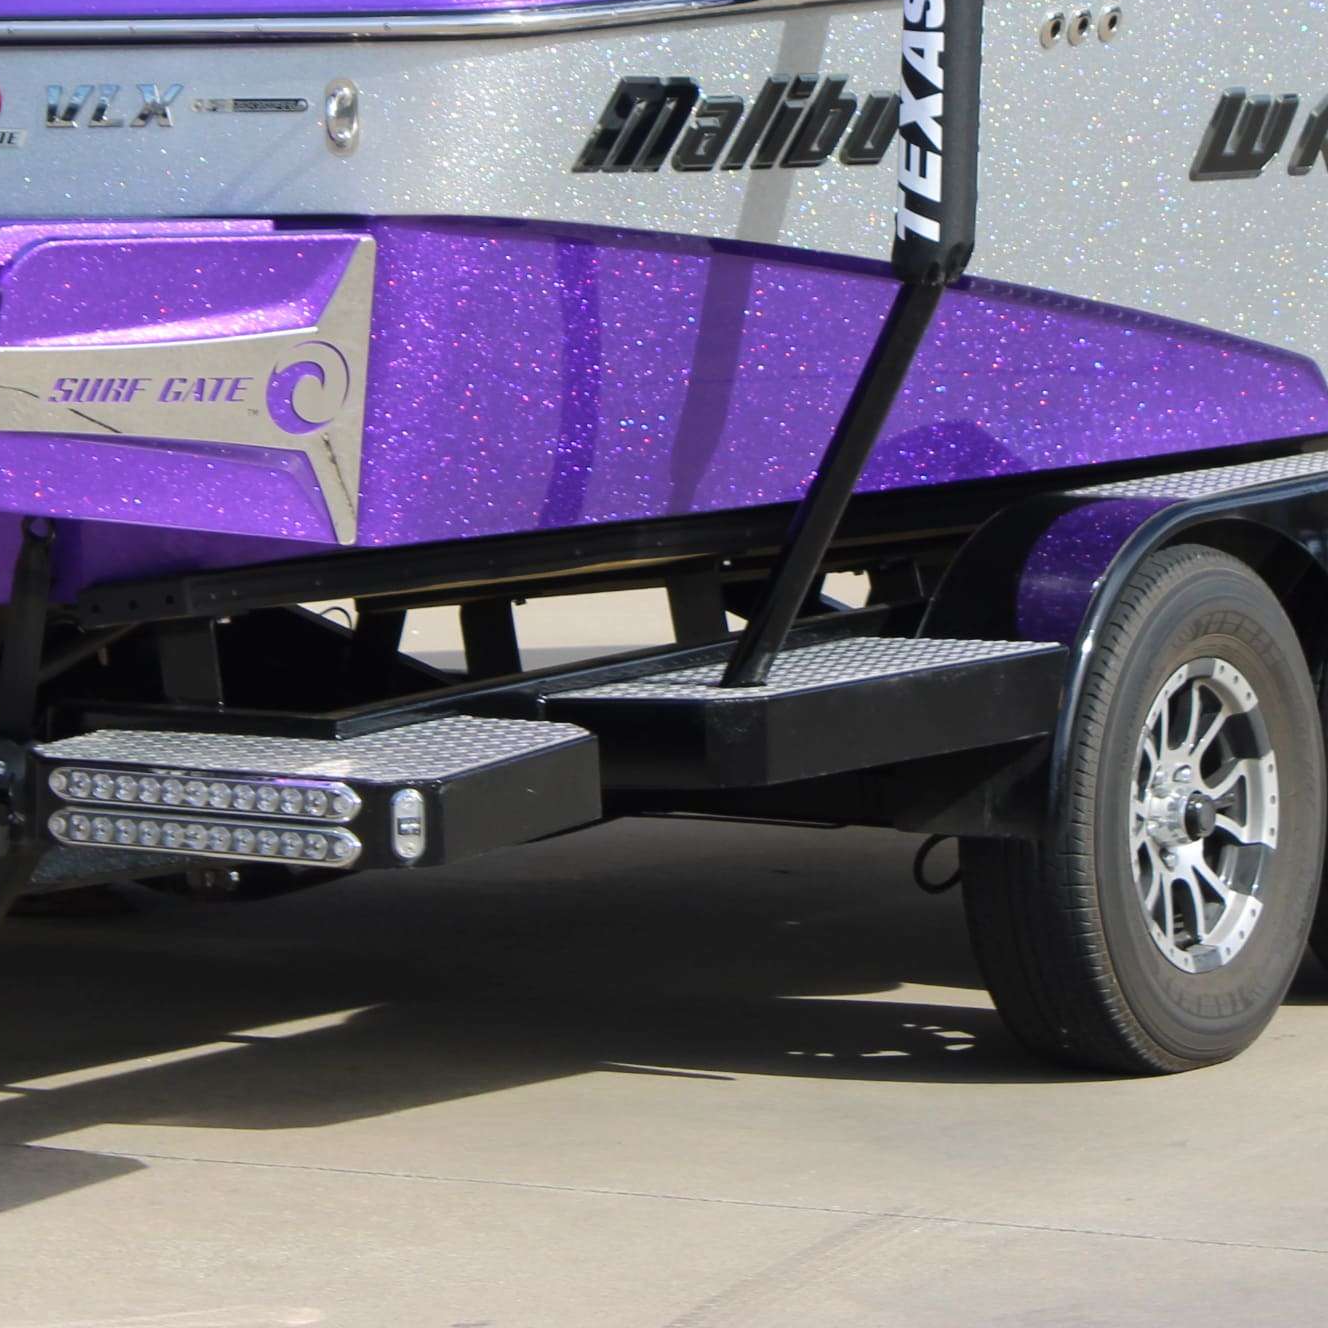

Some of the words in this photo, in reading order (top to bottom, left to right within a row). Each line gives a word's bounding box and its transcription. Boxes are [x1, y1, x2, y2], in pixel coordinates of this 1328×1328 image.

[45, 83, 184, 128] VLX
[572, 73, 901, 173] Malibu
[48, 377, 152, 403] SURF
[157, 376, 254, 403] GATE
